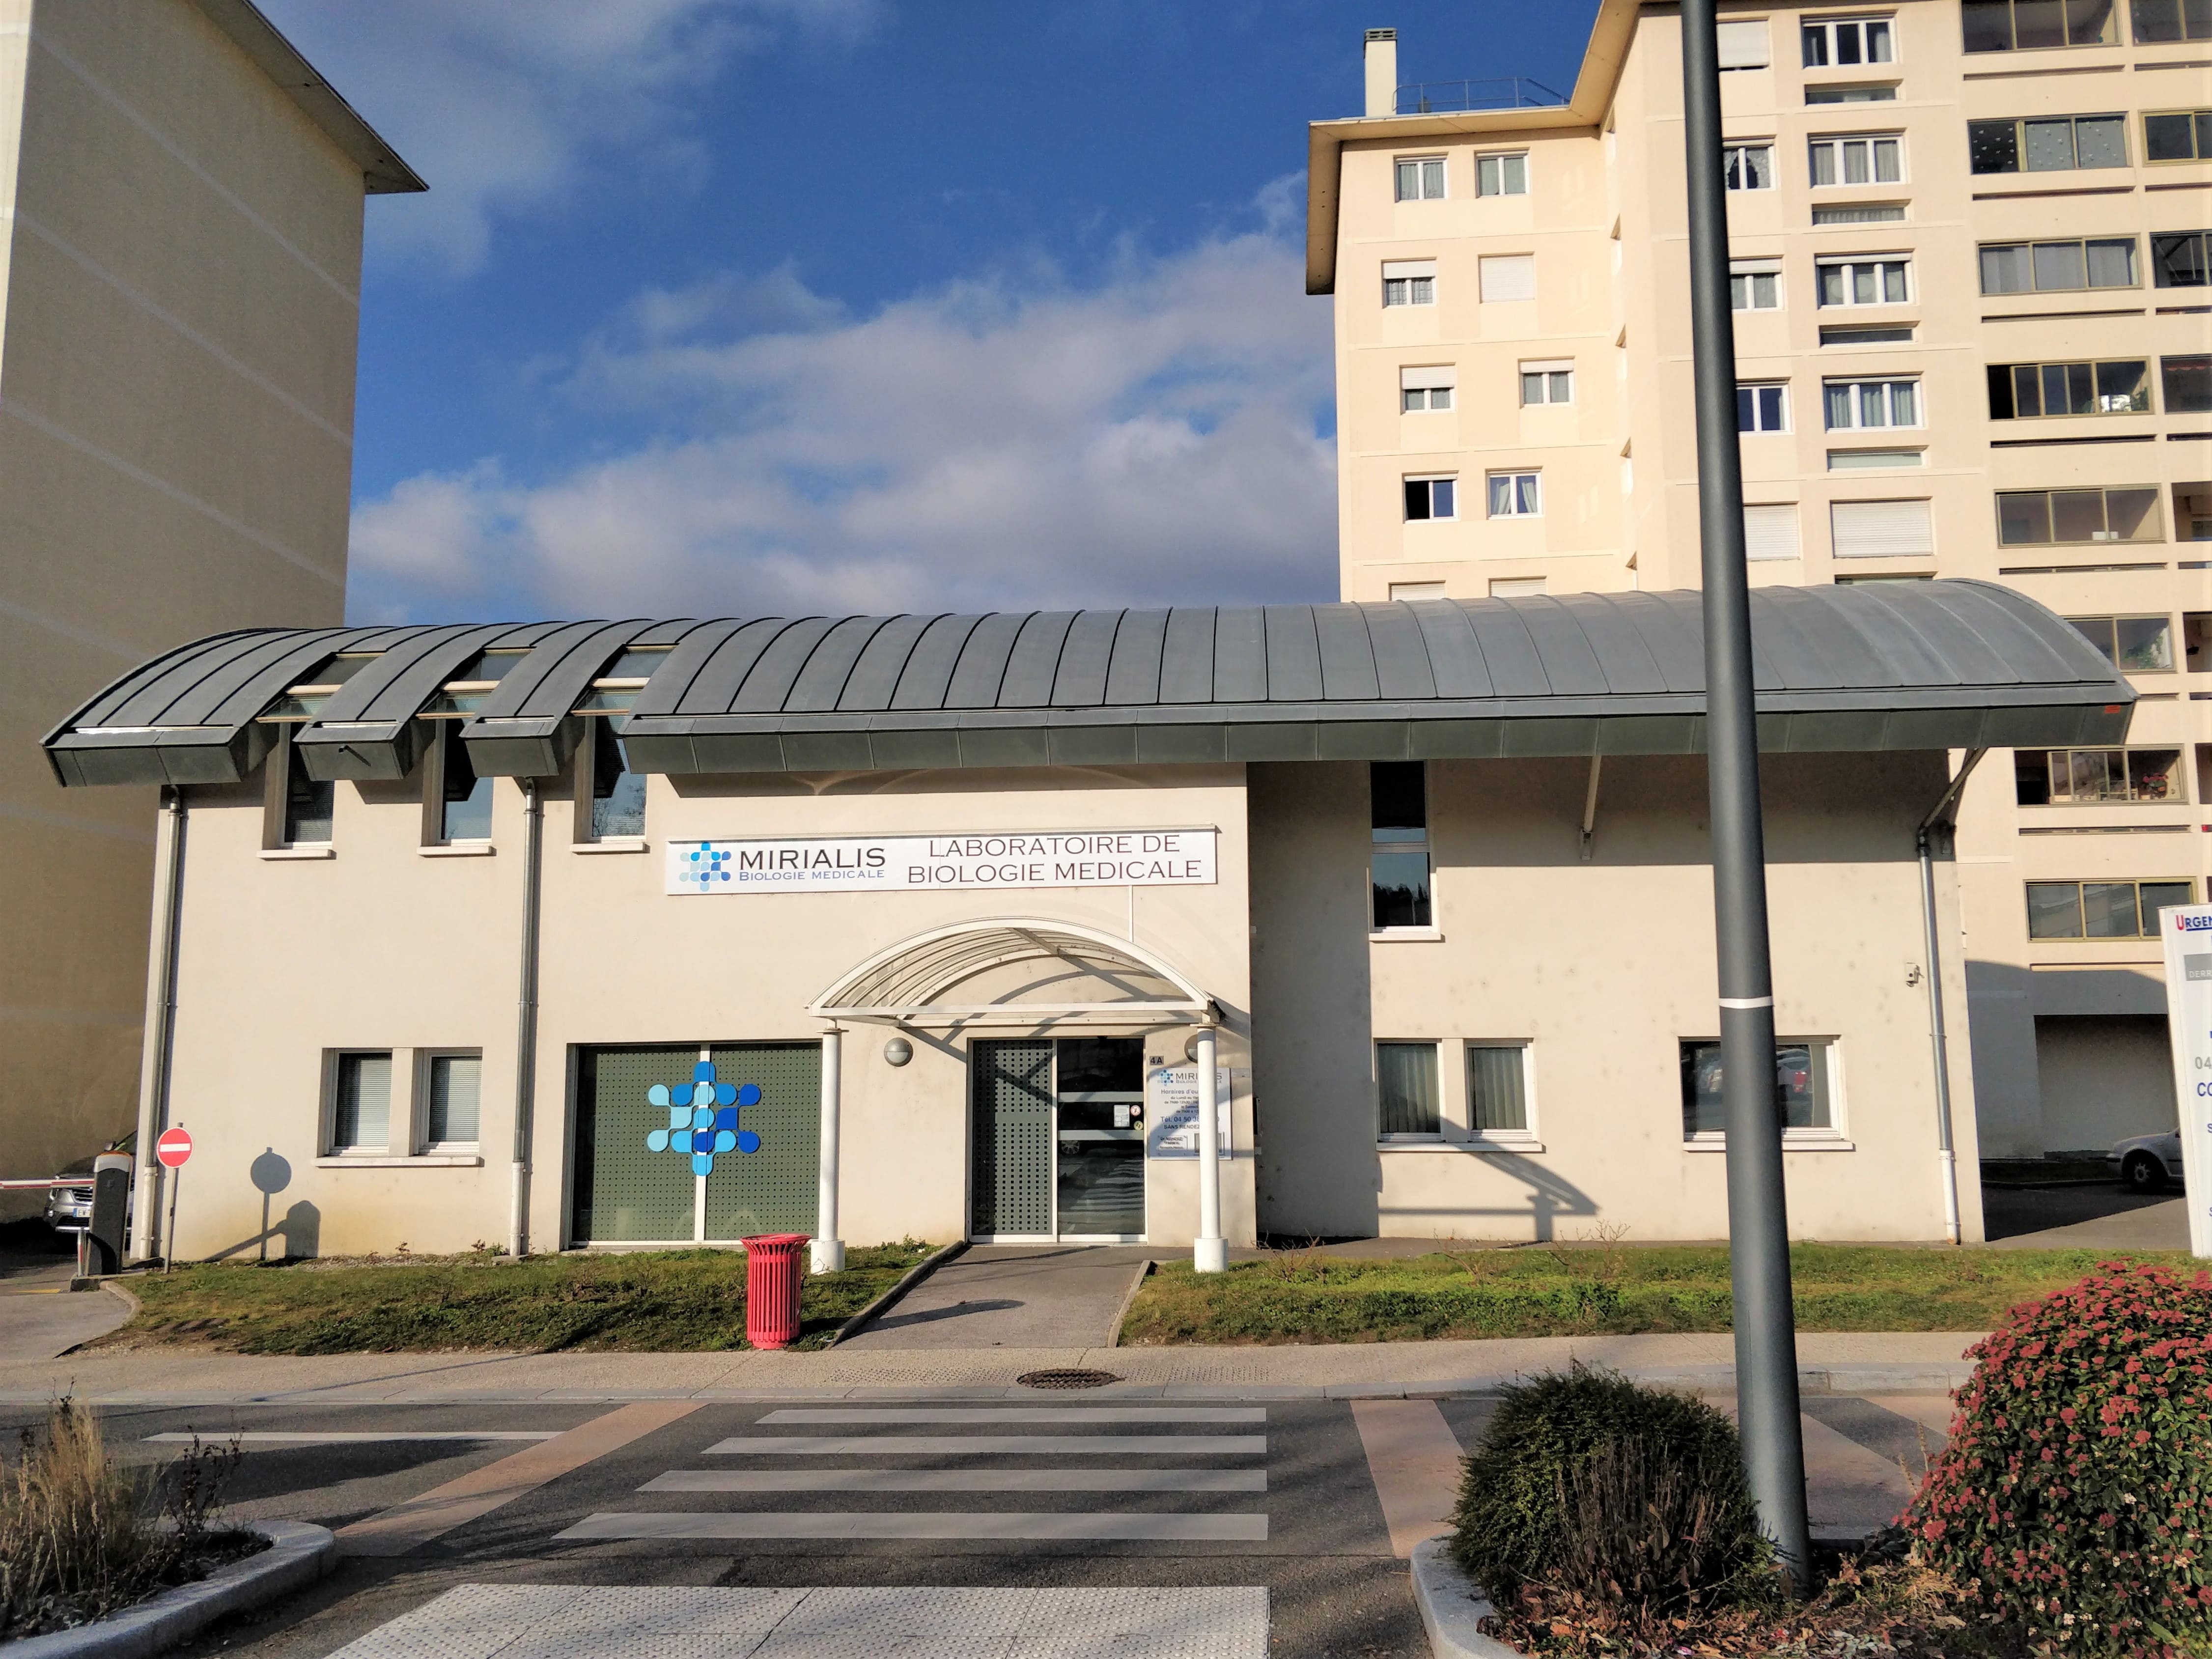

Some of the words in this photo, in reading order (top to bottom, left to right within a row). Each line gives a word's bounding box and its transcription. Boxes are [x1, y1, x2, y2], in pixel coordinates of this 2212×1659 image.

[929, 836, 1132, 857] LABORATOIRE
[1143, 835, 1180, 853] DE
[740, 847, 886, 870] MIRIALIS
[739, 872, 806, 881] BIOLOGIE
[812, 870, 885, 879] MEDICALE
[908, 864, 1044, 883] BIOLOGIE
[1055, 860, 1202, 880] MEDICALE
